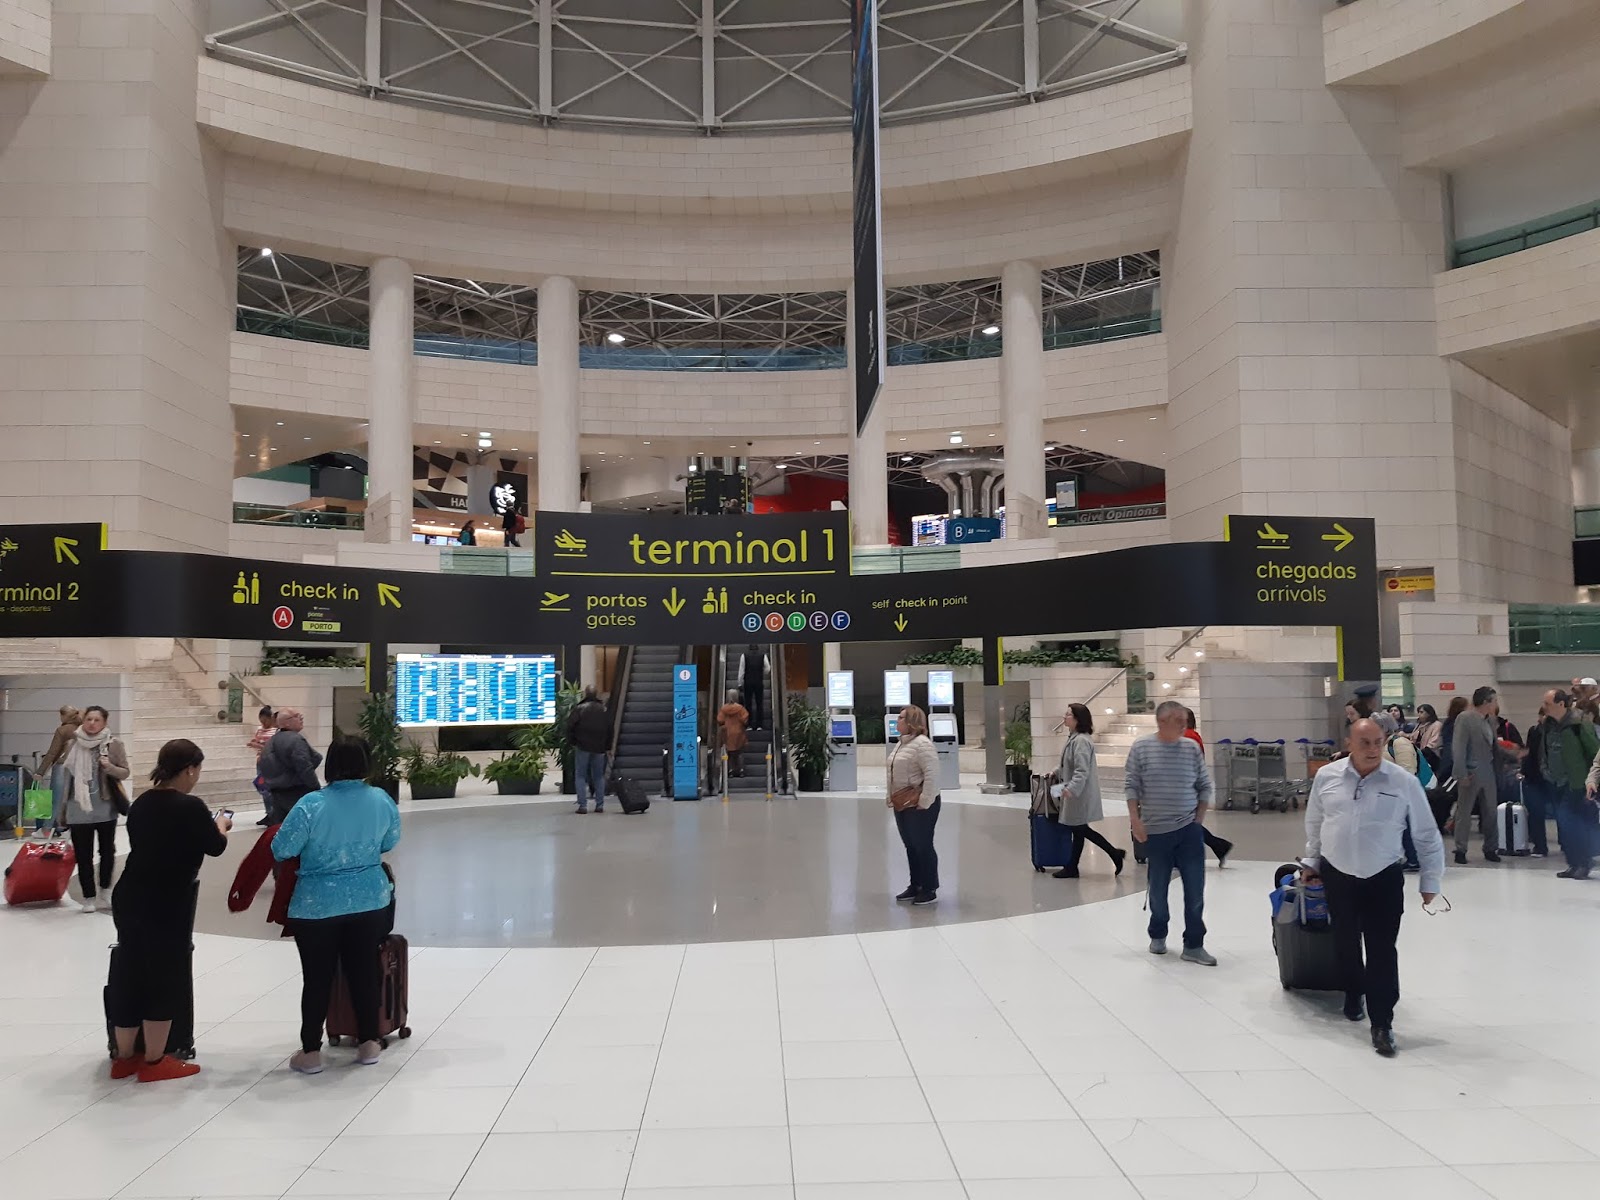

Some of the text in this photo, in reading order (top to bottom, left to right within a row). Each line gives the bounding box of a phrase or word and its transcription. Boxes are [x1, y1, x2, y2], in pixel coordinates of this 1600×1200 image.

[1106, 507, 1159, 520] Opinions
[628, 528, 834, 565] terminal 1
[1256, 560, 1357, 583] chegadas
[67, 582, 79, 600] 2
[280, 580, 359, 600] check in
[743, 589, 816, 605] check in
[1257, 584, 1327, 602] arrivals
[587, 593, 647, 611] portas
[872, 595, 968, 609] self check in point
[278, 610, 289, 624] A
[586, 612, 637, 629] gates
[748, 614, 845, 628] B C D E F
